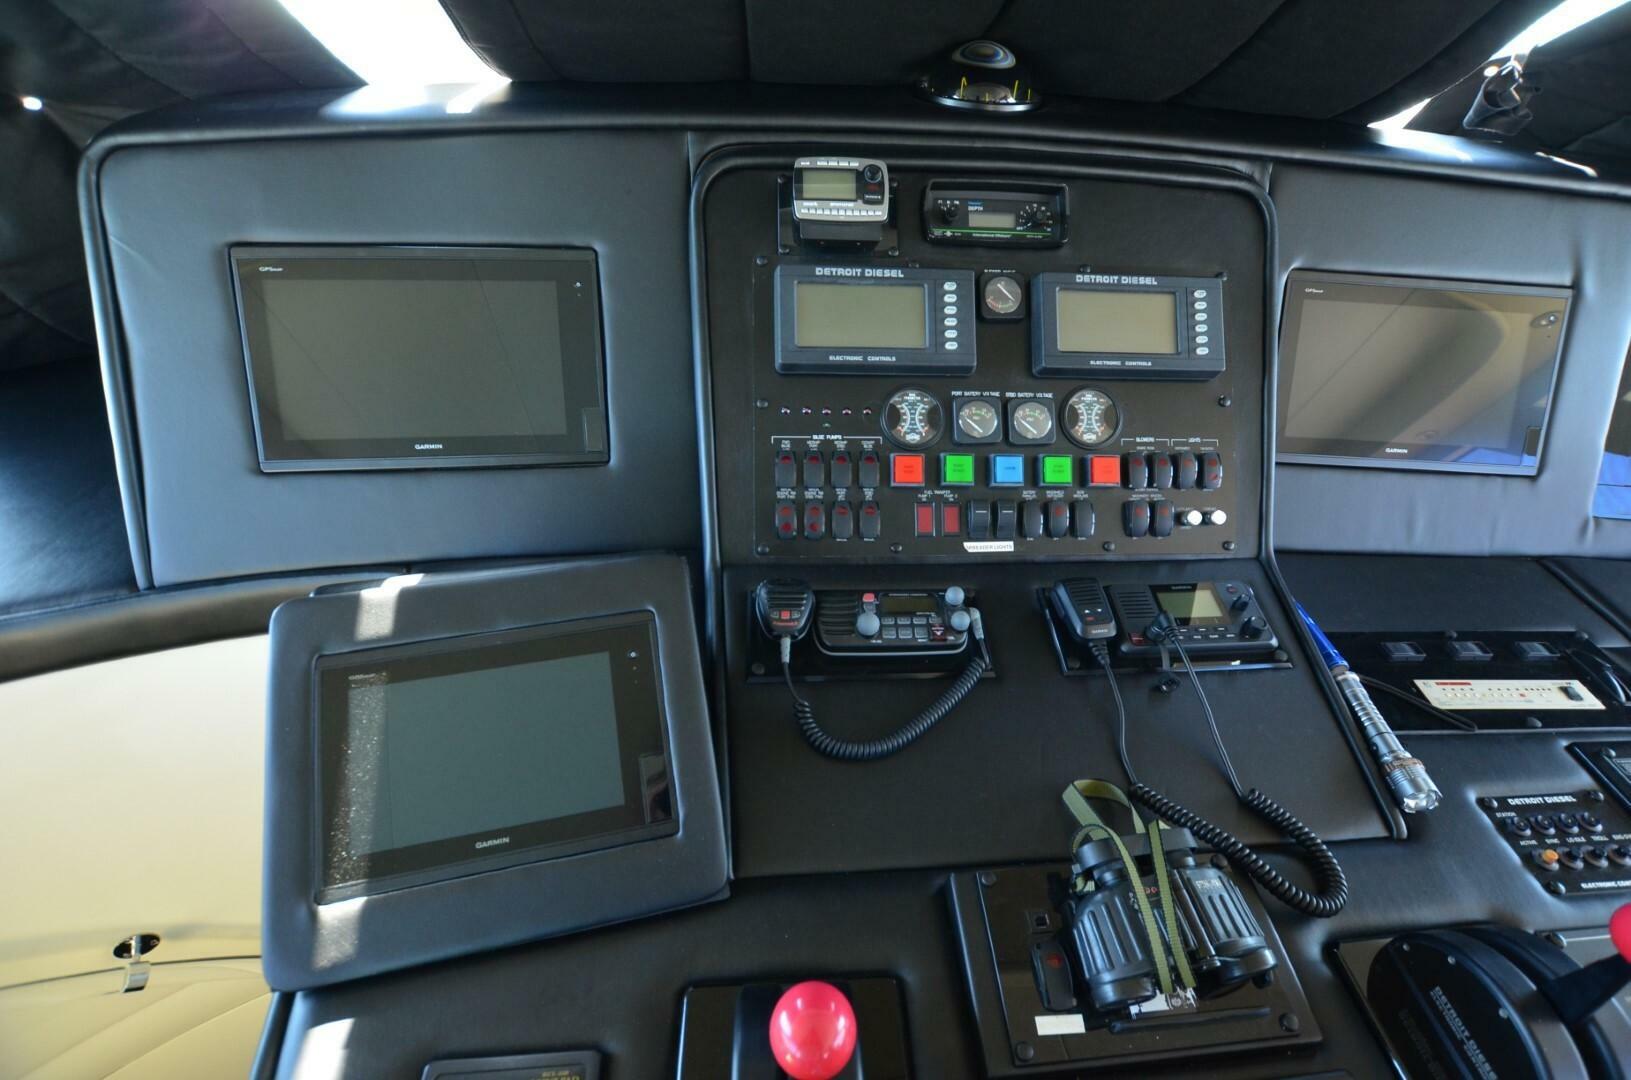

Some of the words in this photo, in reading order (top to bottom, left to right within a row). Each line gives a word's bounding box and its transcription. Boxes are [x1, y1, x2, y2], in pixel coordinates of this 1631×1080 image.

[815, 267, 862, 277] DETROIT
[864, 268, 905, 278] DIESEL
[1075, 274, 1119, 284] DETROIT
[1121, 275, 1158, 286] DIESEL
[1507, 797, 1544, 805] DETROIT
[1544, 795, 1577, 804] DIESEL
[474, 837, 510, 849] GARMIN
[1580, 881, 1618, 889] ELECTRONIC
[1434, 985, 1470, 1038] DETROIT
